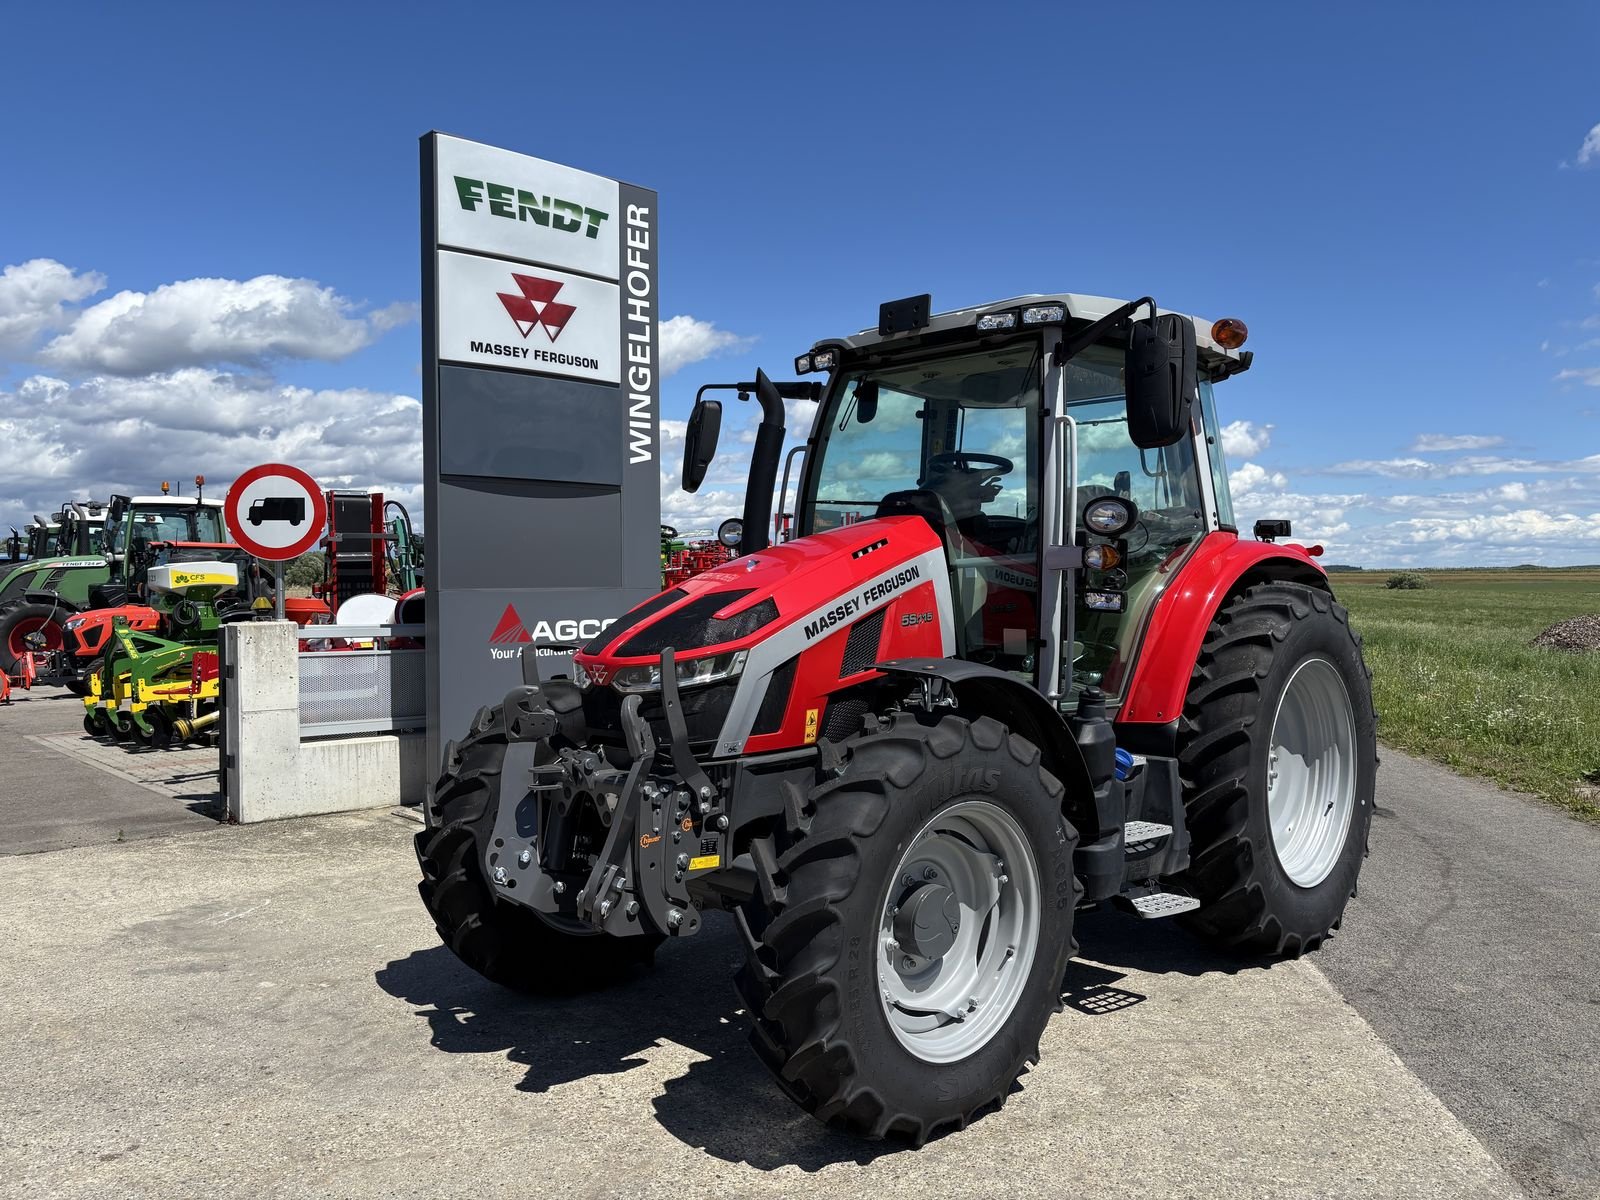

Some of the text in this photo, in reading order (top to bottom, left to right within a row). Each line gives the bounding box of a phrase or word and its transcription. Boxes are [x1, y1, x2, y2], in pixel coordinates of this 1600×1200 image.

[453, 175, 609, 239] FENDT
[470, 341, 599, 370] MASSEY FERGUSON
[626, 203, 652, 465] WINGELHOFER
[804, 565, 920, 640] MASSEY FERGUSON
[490, 648, 515, 659] Your
